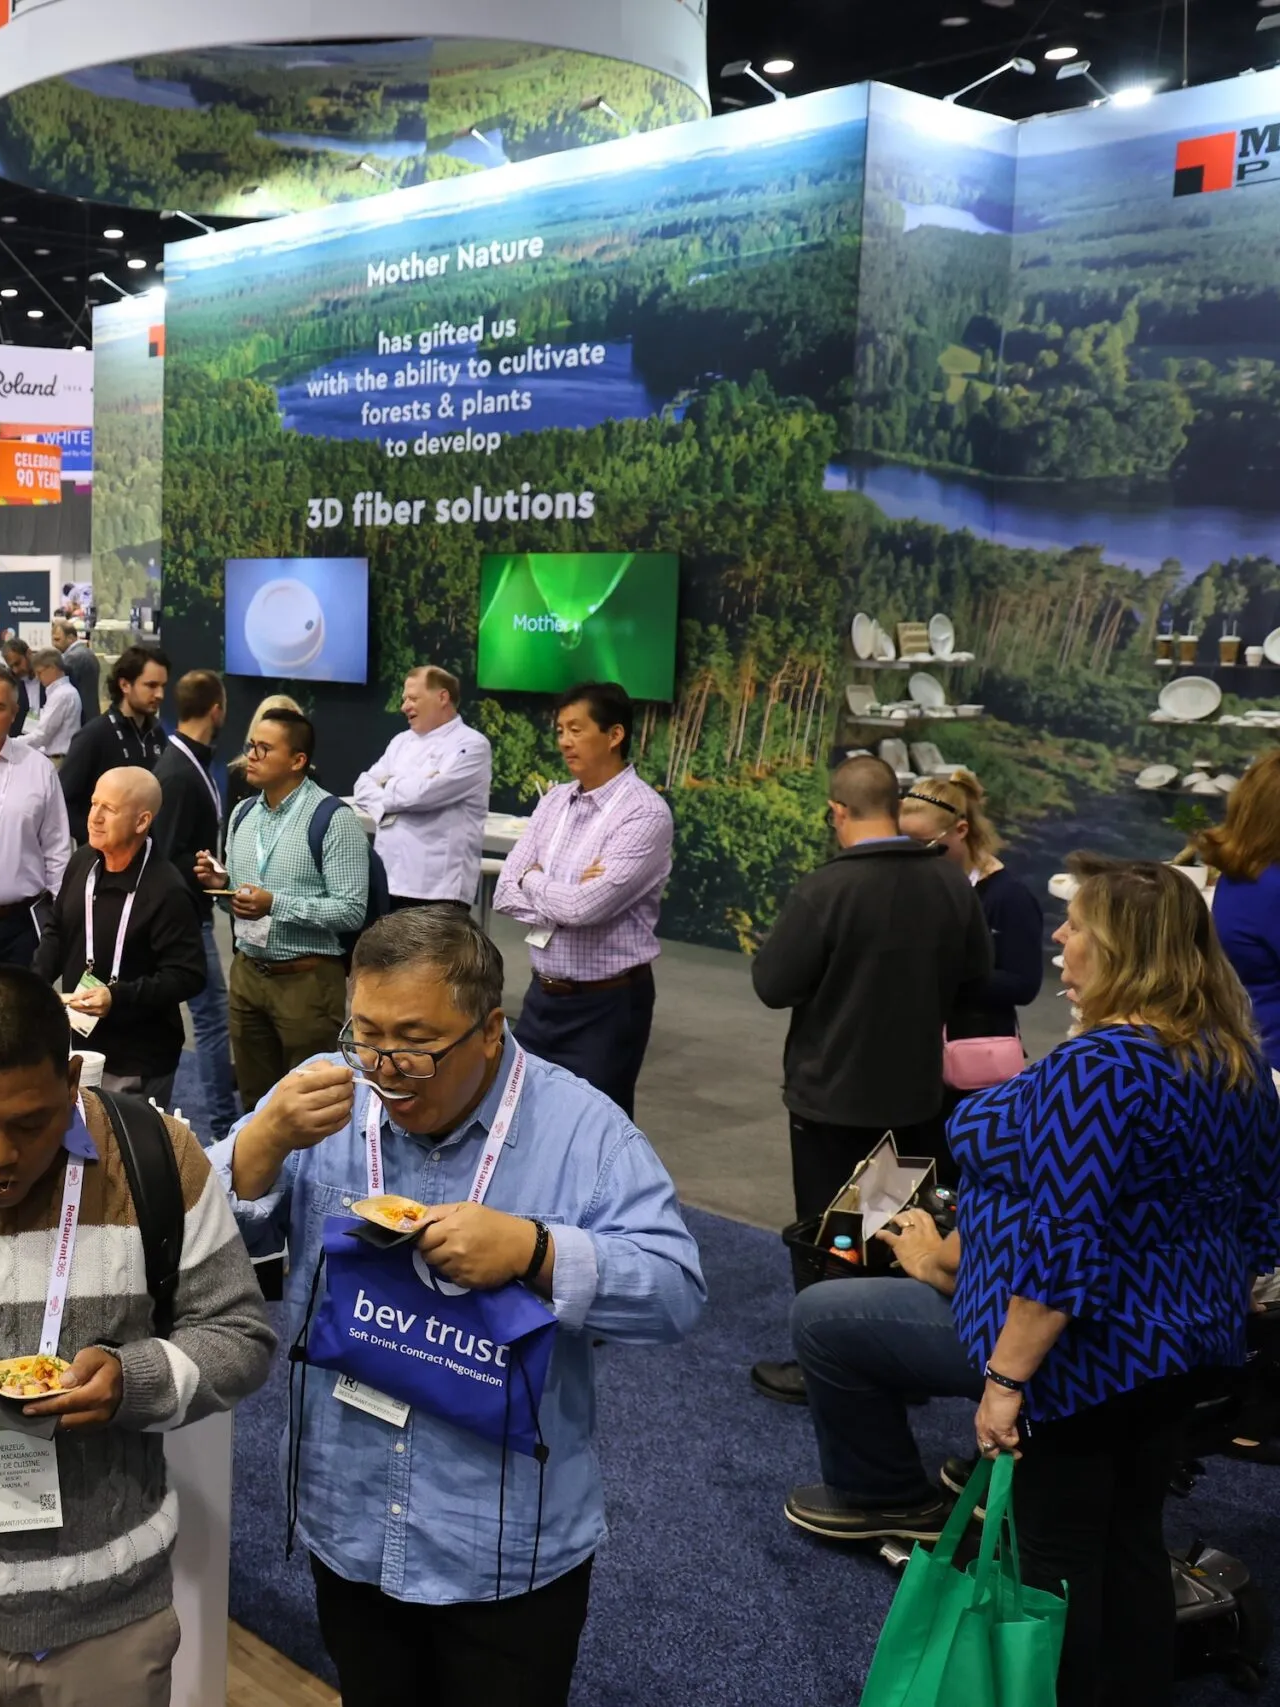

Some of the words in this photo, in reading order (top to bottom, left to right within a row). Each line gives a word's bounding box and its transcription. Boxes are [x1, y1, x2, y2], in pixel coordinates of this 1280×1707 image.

[367, 252, 450, 287] Mother
[457, 236, 545, 271] Nature
[378, 331, 412, 355] has
[418, 315, 484, 355] gifted
[490, 318, 517, 338] us
[306, 371, 348, 398] with
[354, 367, 388, 391] the
[394, 358, 461, 388] ability
[467, 357, 492, 380] to
[498, 342, 606, 375] cultivate
[361, 402, 431, 426] forests
[437, 392, 455, 419] &
[461, 390, 532, 421] plants
[44, 430, 91, 446] WHITE
[384, 437, 408, 458] to
[413, 427, 502, 455] develop
[16, 469, 34, 487] 90
[306, 498, 344, 530] 3D
[352, 491, 426, 527] fiber
[435, 482, 596, 524] solutions
[370, 1124, 380, 1189] Restaurant365
[55, 1204, 76, 1279] Restaurant365
[352, 1288, 417, 1334] bev
[424, 1314, 511, 1368] trust
[348, 1327, 369, 1342] Soft
[370, 1334, 398, 1351] Drink
[399, 1343, 444, 1366] Contract
[444, 1357, 503, 1388] Negotiation
[3, 1461, 13, 1469] DE
[13, 1459, 40, 1468] CUISINE
